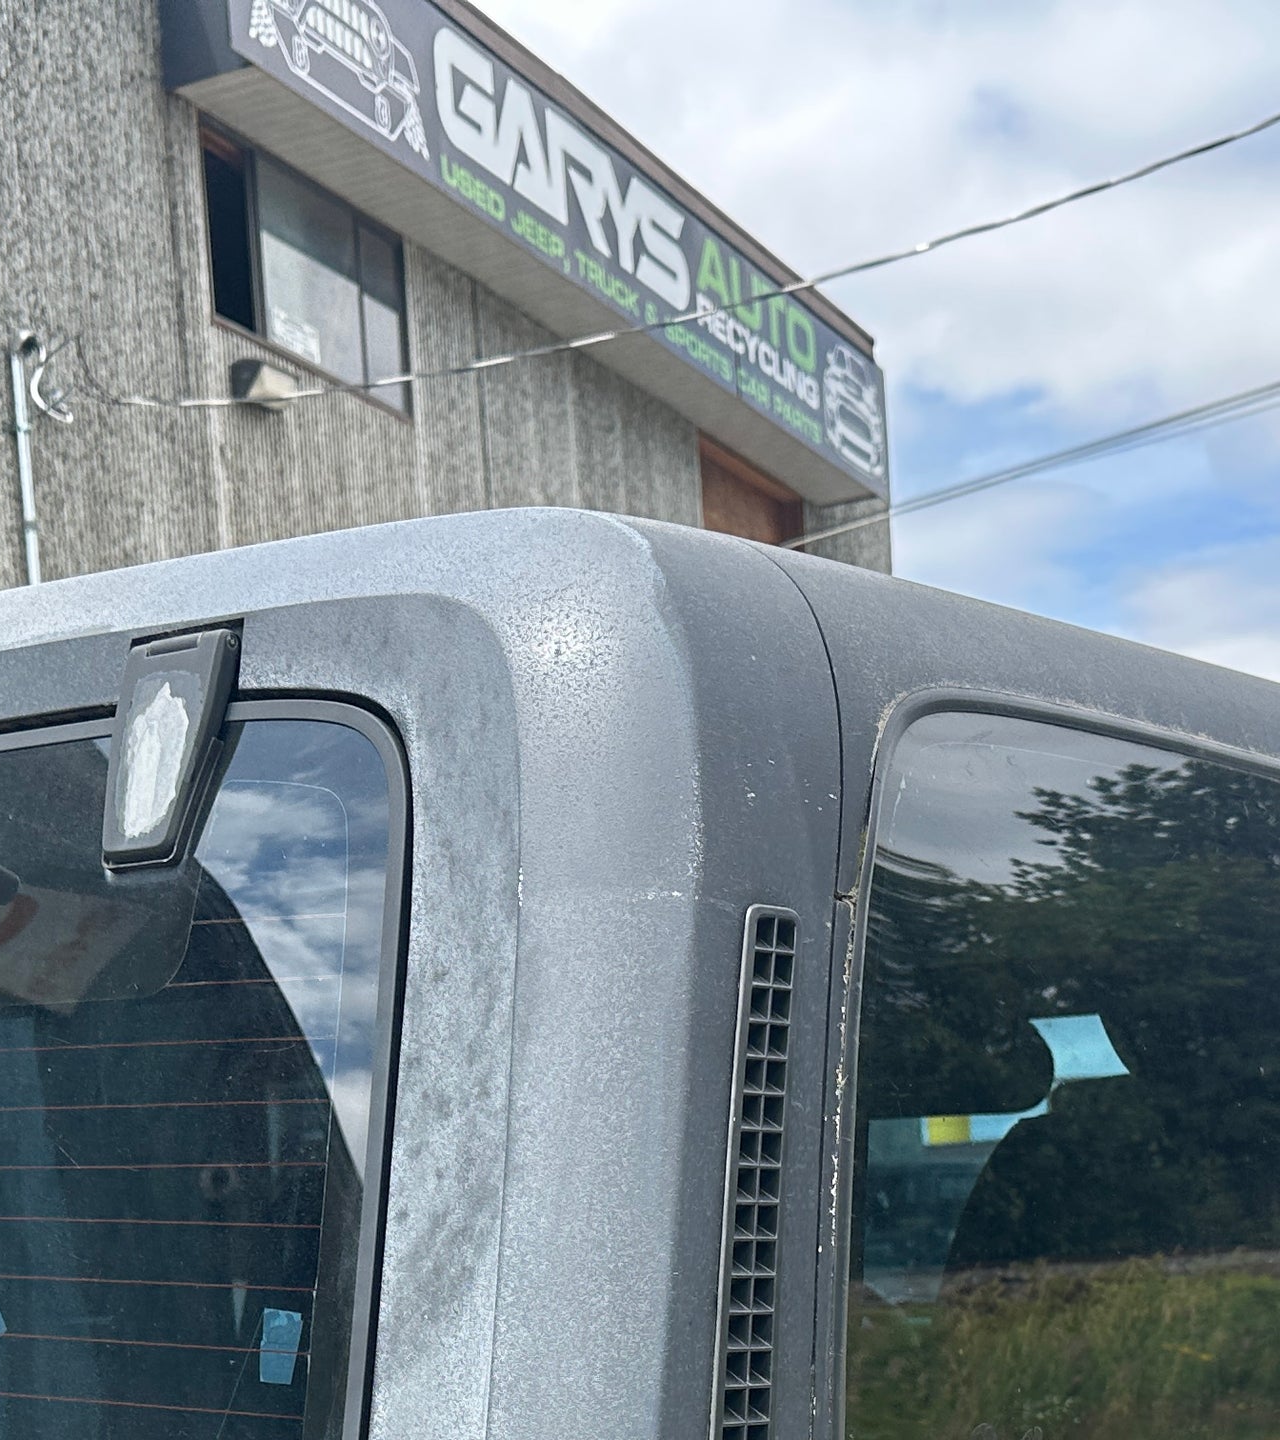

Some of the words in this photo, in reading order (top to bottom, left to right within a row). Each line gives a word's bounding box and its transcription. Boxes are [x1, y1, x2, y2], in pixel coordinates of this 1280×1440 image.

[433, 26, 691, 312] GARYS
[696, 238, 817, 374] AUTO
[440, 152, 506, 222] USED
[574, 249, 641, 318] TRUCK
[663, 315, 733, 383] SPORTS
[773, 393, 822, 445] PARTS
[696, 292, 821, 411] RECYCLING
